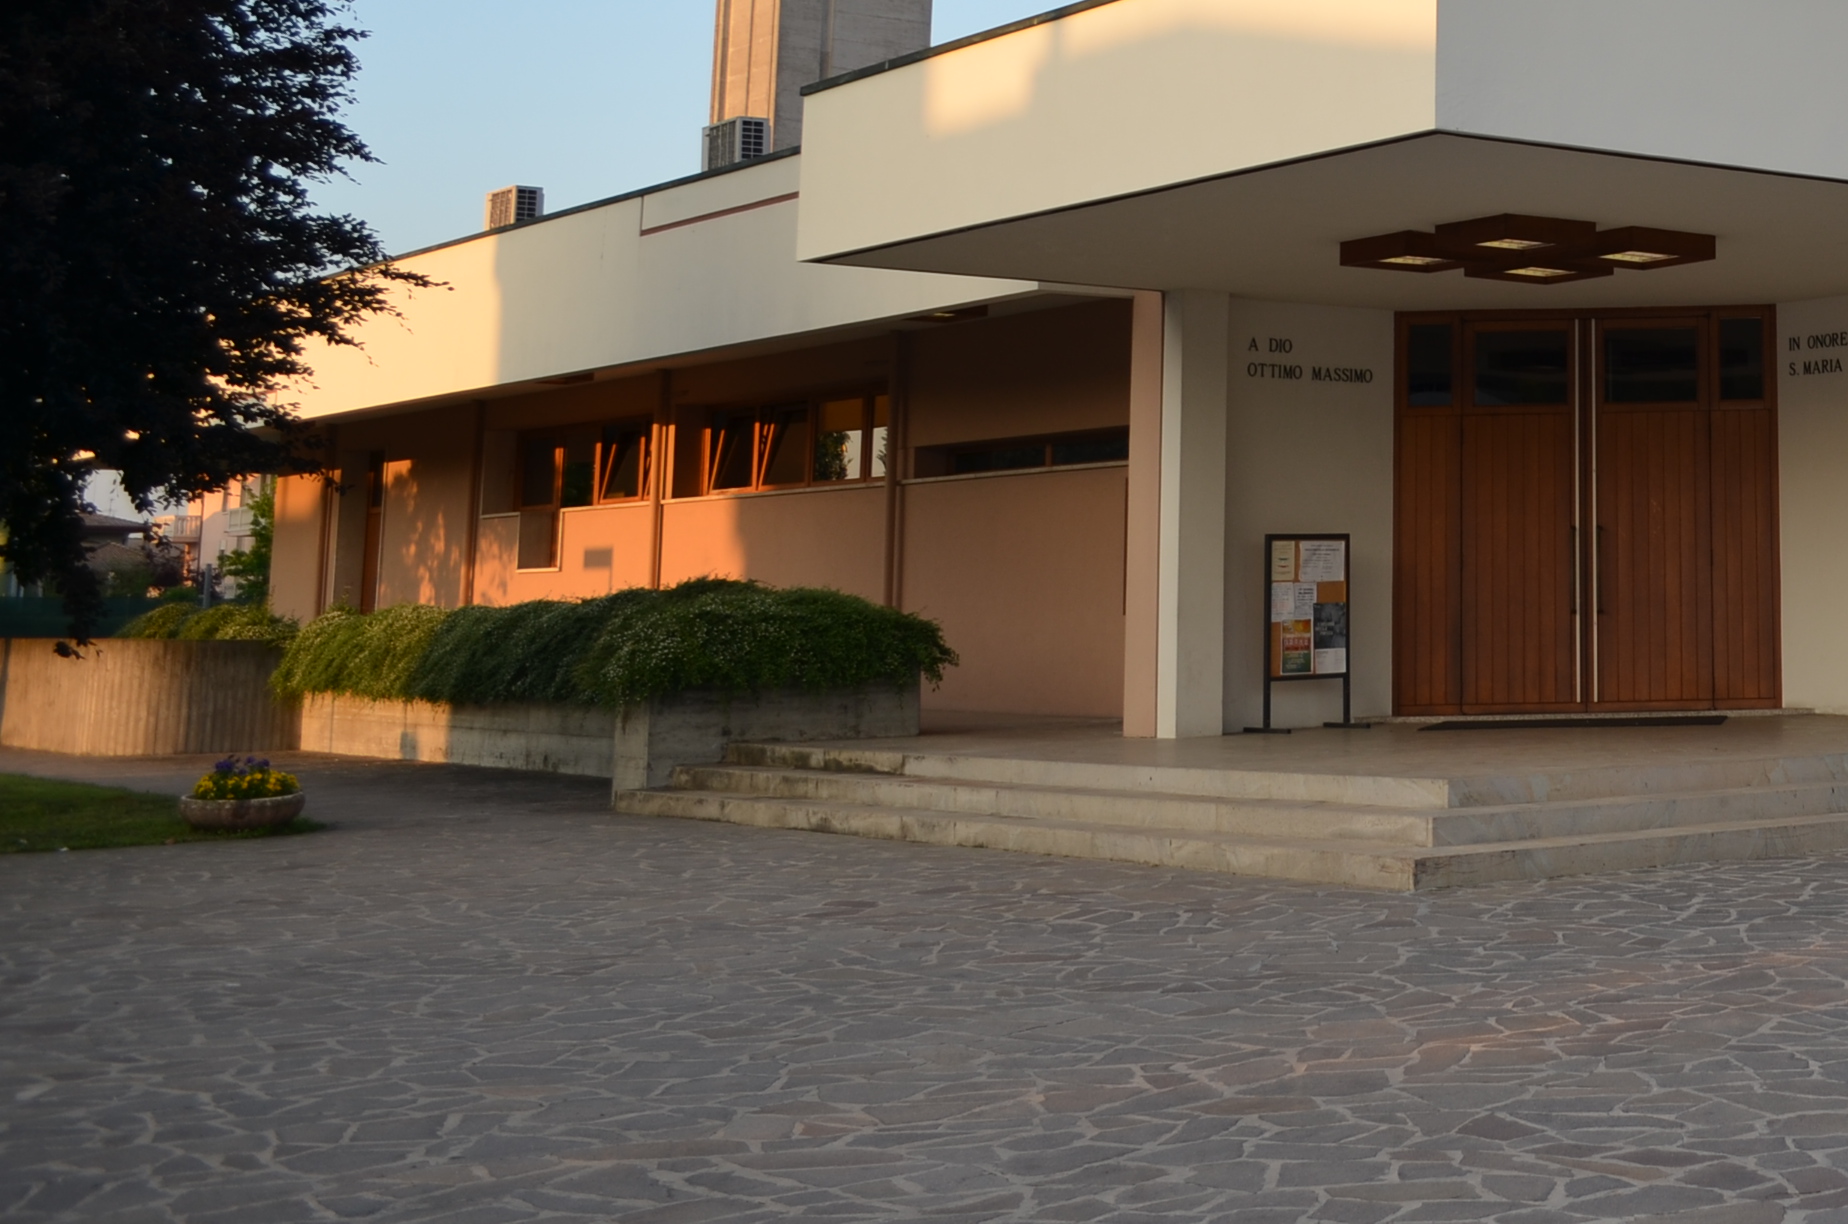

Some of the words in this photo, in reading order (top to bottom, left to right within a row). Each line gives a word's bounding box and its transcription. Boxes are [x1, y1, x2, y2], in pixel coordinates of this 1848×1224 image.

[1248, 337, 1259, 352] A
[1268, 338, 1293, 353] DIO
[1789, 336, 1800, 351] IN
[1807, 331, 1848, 349] ONORE
[1247, 362, 1303, 380] OTTIMO
[1311, 366, 1373, 383] MASSIMO
[1789, 362, 1799, 376] S.
[1803, 358, 1843, 376] MARIA
